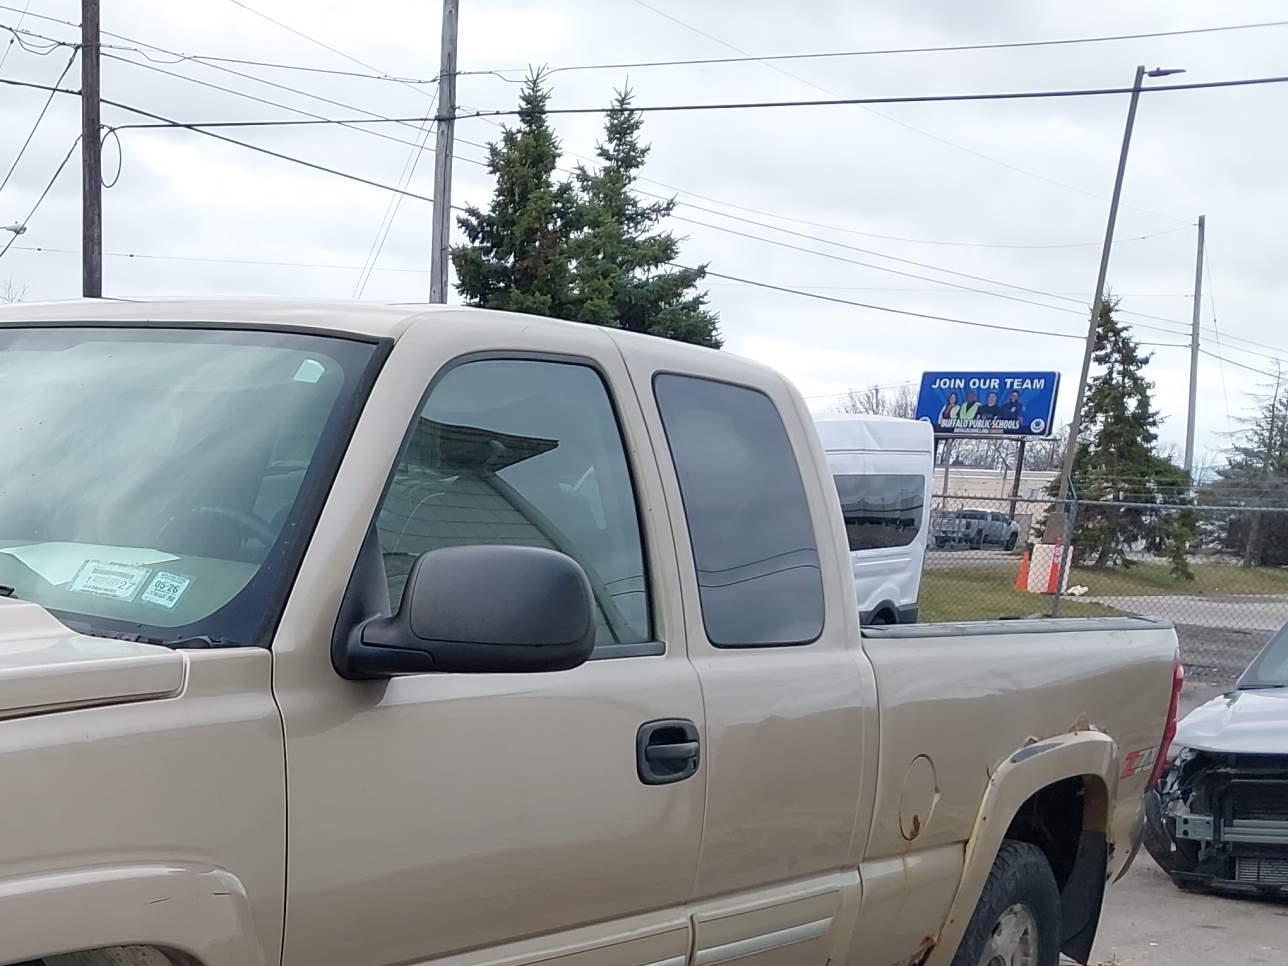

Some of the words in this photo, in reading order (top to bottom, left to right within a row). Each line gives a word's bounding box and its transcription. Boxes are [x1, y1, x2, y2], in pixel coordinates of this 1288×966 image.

[932, 378, 965, 389] JOIN
[969, 378, 1000, 389] OUR
[1005, 378, 1045, 389] TEAM
[941, 418, 968, 428] BUFFALO
